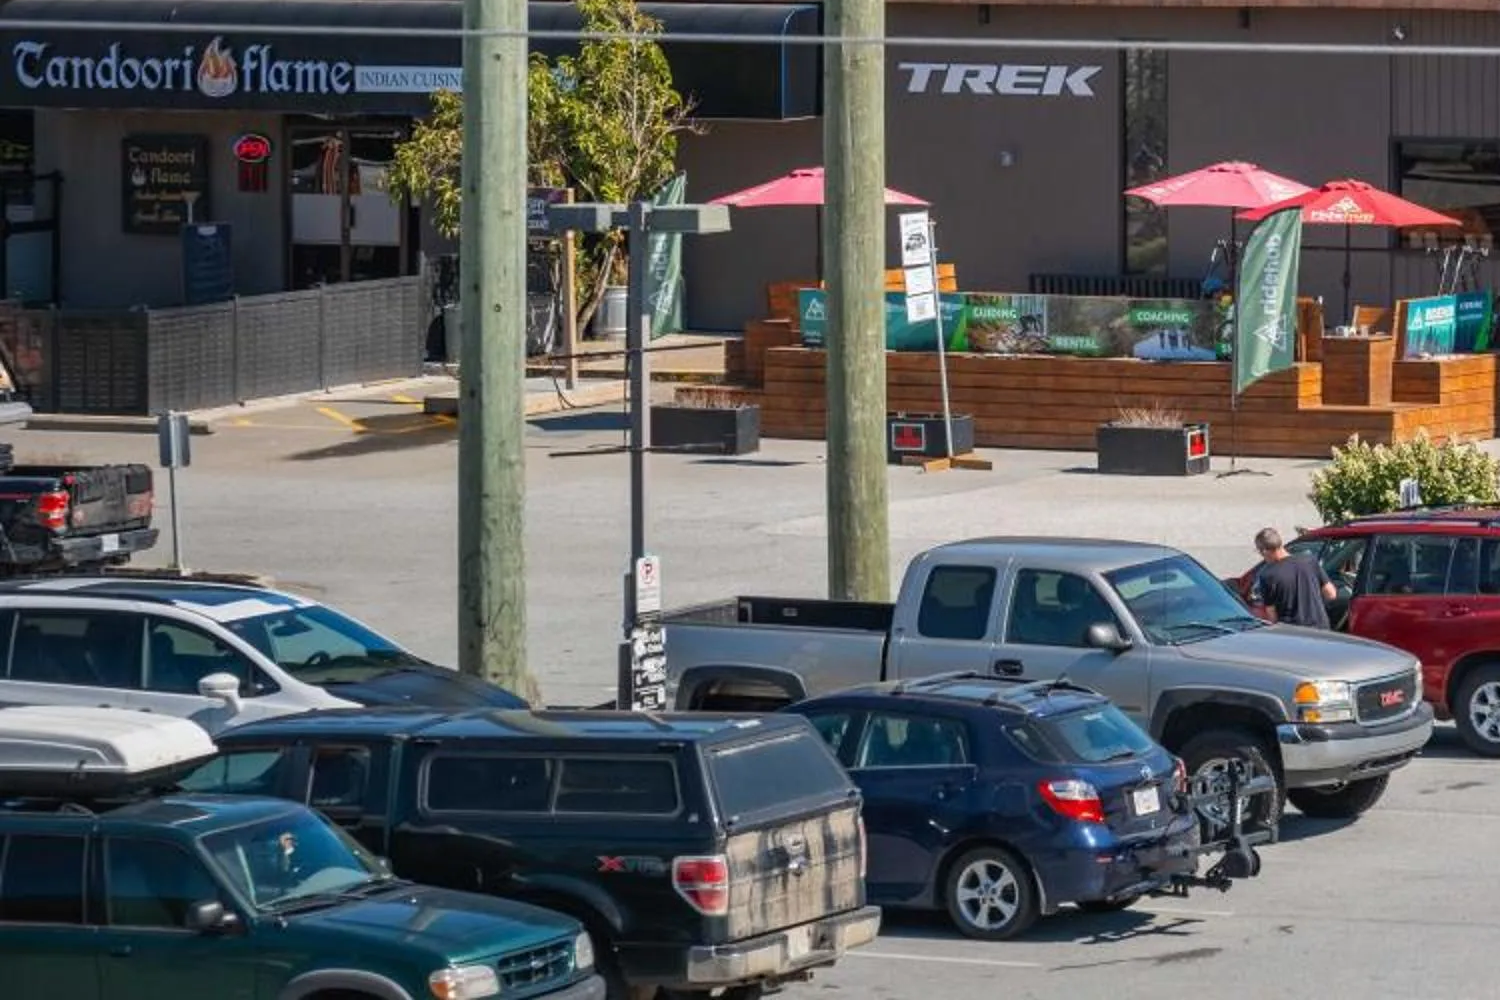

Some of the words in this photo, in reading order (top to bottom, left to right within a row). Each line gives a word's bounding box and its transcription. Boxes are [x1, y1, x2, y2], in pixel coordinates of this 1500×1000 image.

[12, 40, 195, 90] Tandoori
[241, 43, 353, 95] flame
[361, 71, 409, 87] INDIAN
[412, 73, 463, 88] CUISIN
[897, 62, 1103, 96] TREK
[1260, 233, 1282, 315] ridehub
[1136, 310, 1189, 323] COACHING
[1055, 336, 1100, 350] RENTAL
